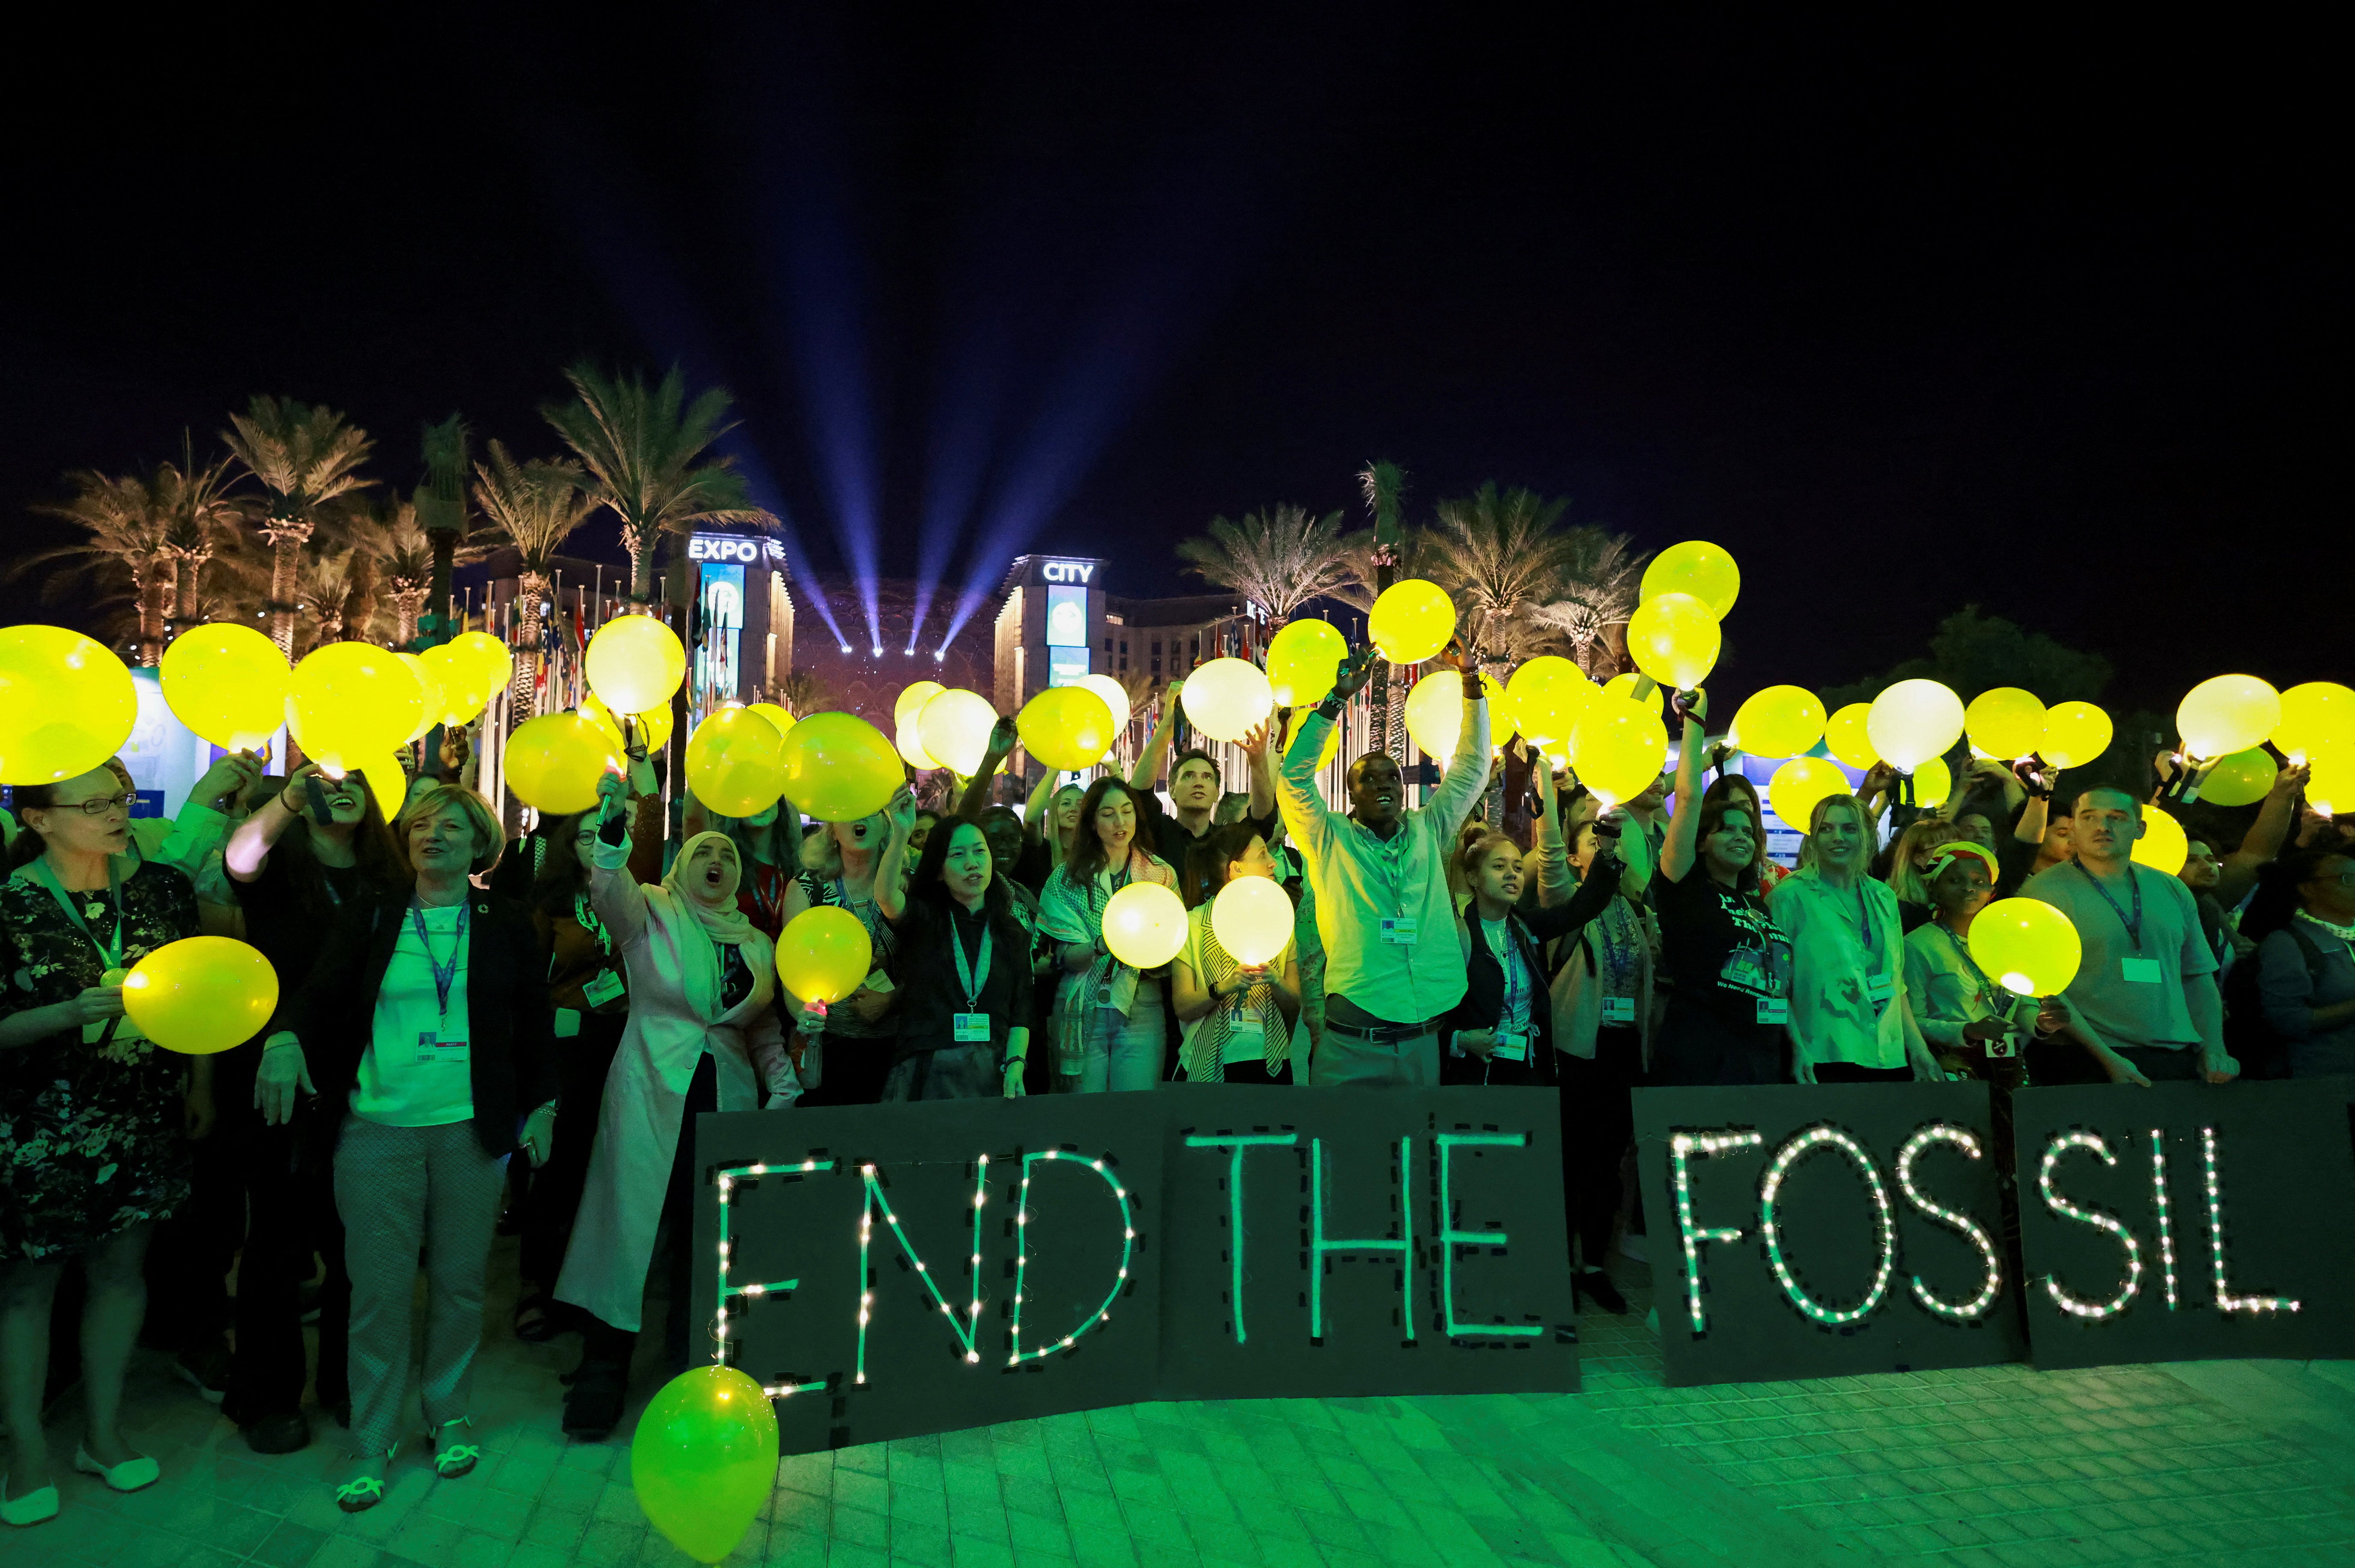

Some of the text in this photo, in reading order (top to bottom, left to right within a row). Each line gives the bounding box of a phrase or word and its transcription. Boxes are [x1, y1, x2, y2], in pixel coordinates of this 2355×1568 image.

[689, 539, 757, 561] EXPO
[1043, 563, 1094, 583] CITY
[1728, 984, 1744, 992] Need
[720, 1126, 2301, 1395] END THE FOSSIL
